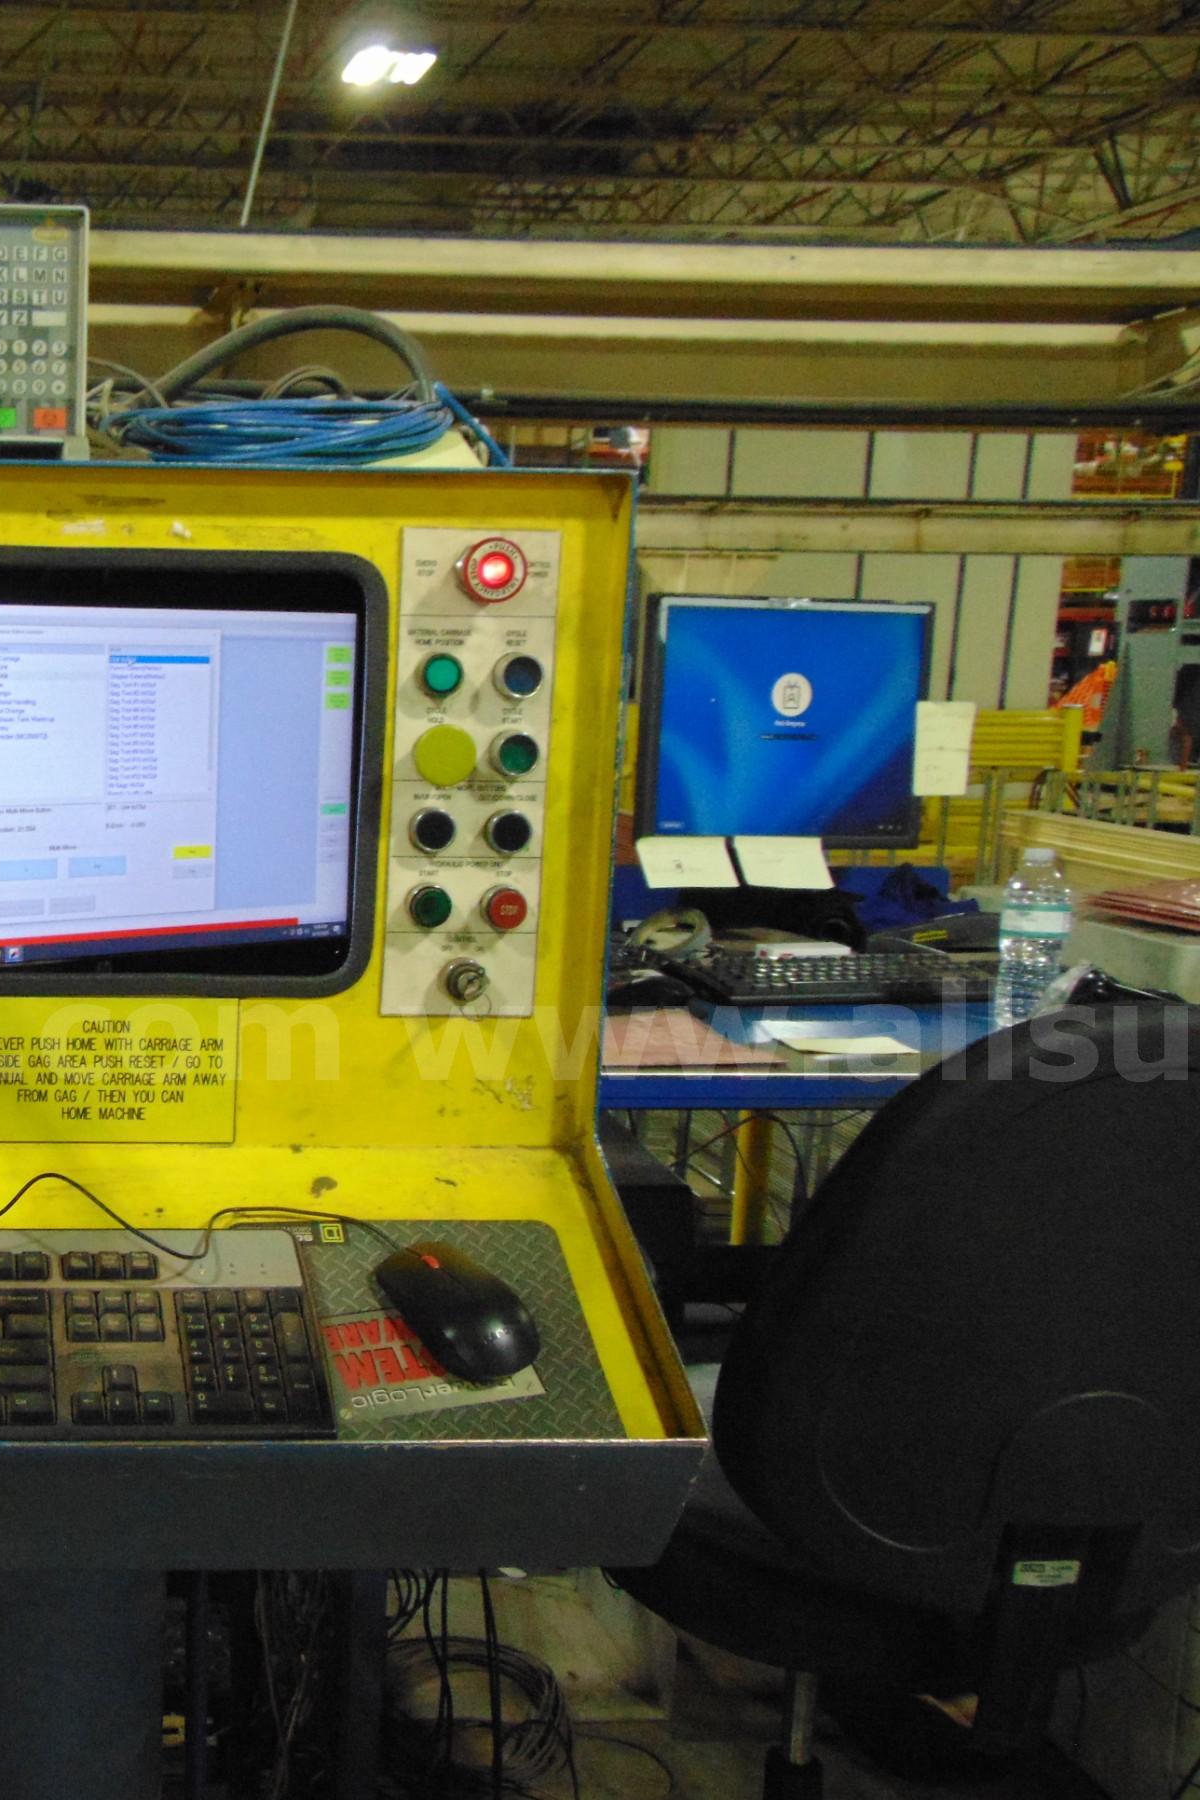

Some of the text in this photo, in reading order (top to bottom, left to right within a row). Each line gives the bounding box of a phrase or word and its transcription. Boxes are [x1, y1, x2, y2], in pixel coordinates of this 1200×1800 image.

[82, 1020, 131, 1034] CAUTION
[30, 1037, 61, 1051] PUSH
[66, 1037, 96, 1051] HOME
[104, 1037, 132, 1051] WITH
[139, 1037, 192, 1051] CARRIAGE
[200, 1037, 224, 1051] ARM
[28, 1055, 50, 1068] GAG
[57, 1055, 87, 1068] AREA
[93, 1055, 123, 1068] PUSH
[129, 1055, 165, 1068] RESET
[185, 1055, 200, 1068] GO
[209, 1055, 223, 1068] TO
[35, 1072, 57, 1086] AND
[64, 1072, 95, 1086] MOVE
[102, 1072, 155, 1086] CARRIAGE
[163, 1072, 187, 1086] ARM
[193, 1072, 226, 1086] AWAY
[16, 1089, 48, 1103] FROM
[54, 1089, 77, 1103] GAG
[97, 1089, 125, 1103] THEN
[133, 1089, 155, 1103] YOU
[161, 1089, 184, 1103] CAN
[61, 1107, 146, 1121] HOME MACHINE
[323, 1317, 416, 1350] WARE
